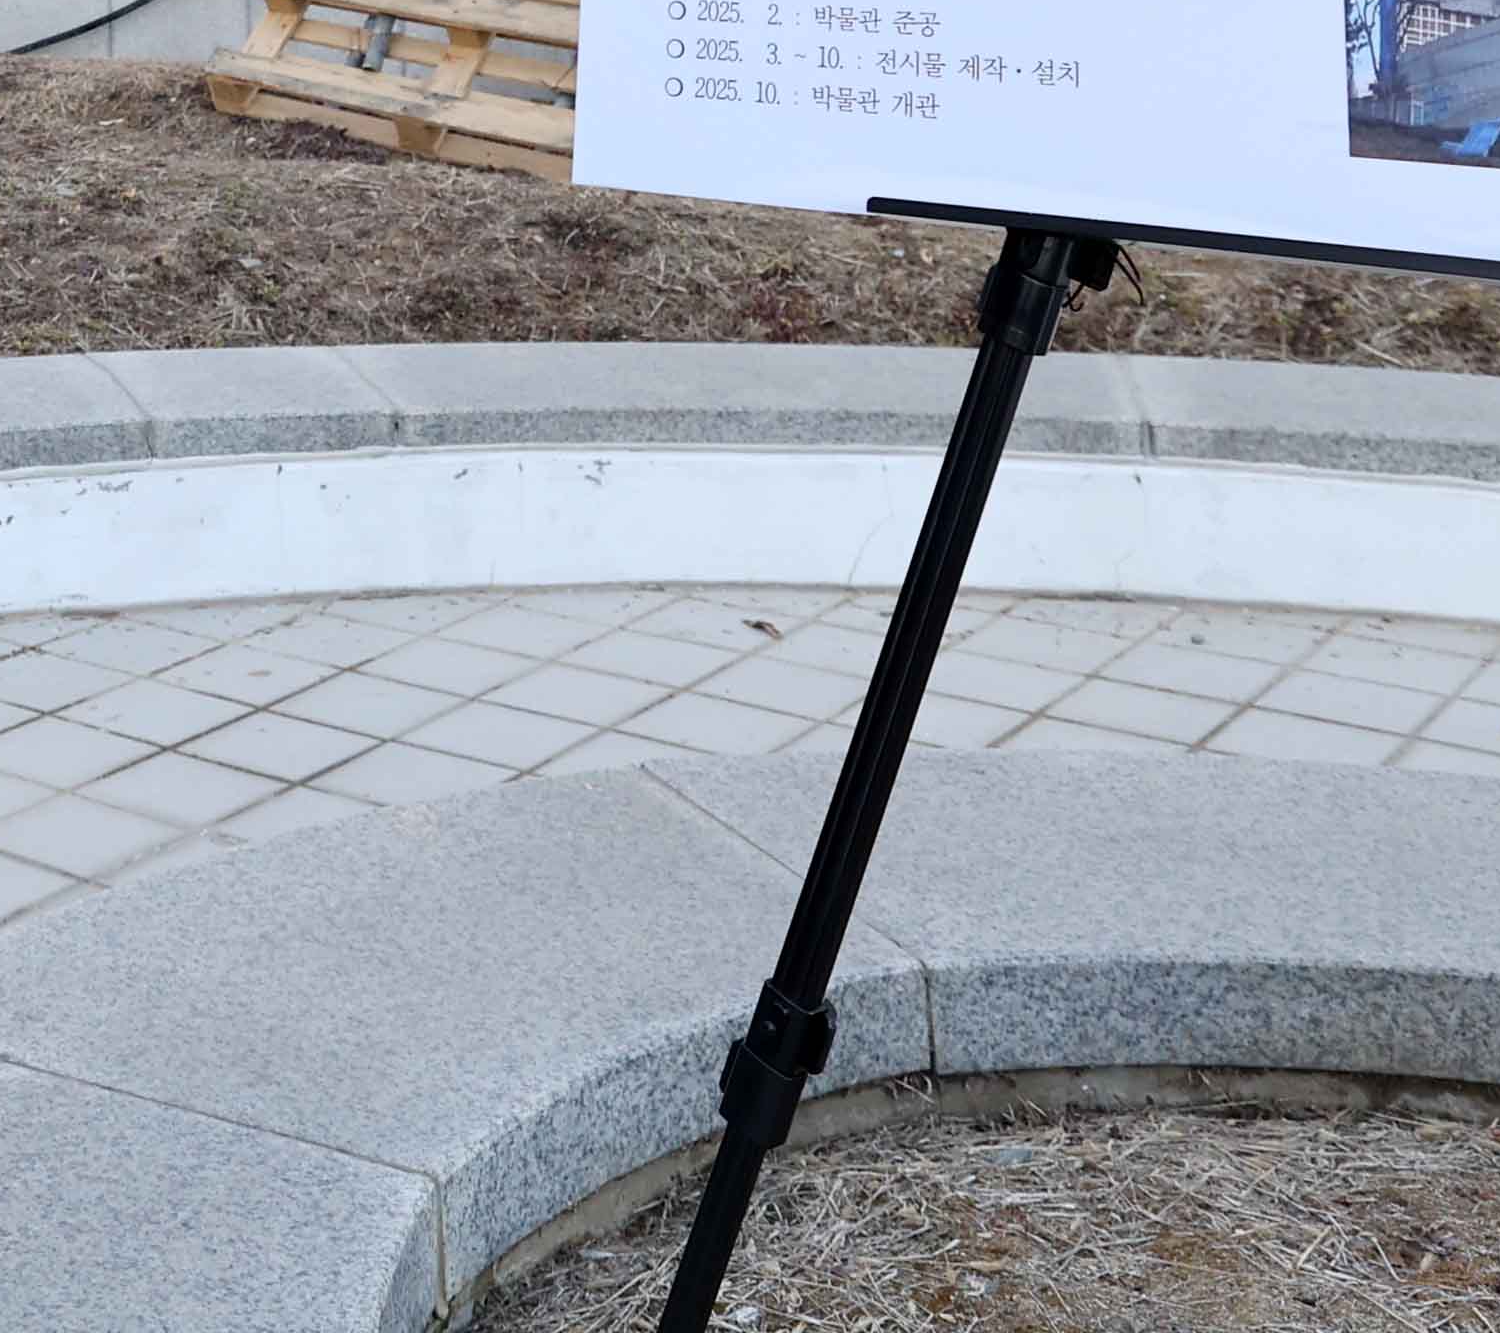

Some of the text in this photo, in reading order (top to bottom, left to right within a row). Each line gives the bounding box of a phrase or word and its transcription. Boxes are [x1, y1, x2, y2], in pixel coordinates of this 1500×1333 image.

[697, 0, 744, 23] 2025.
[768, 4, 782, 26] 2.
[814, 5, 882, 33] 박물관
[892, 11, 941, 37] 준공
[696, 38, 743, 62] 2025.
[766, 42, 782, 65] 3.
[817, 46, 843, 69] 10.
[876, 49, 946, 78] 전시물
[694, 77, 742, 101] 2025.
[754, 81, 780, 105] 10.
[812, 85, 880, 114] 박물관
[892, 91, 940, 119] 개관
